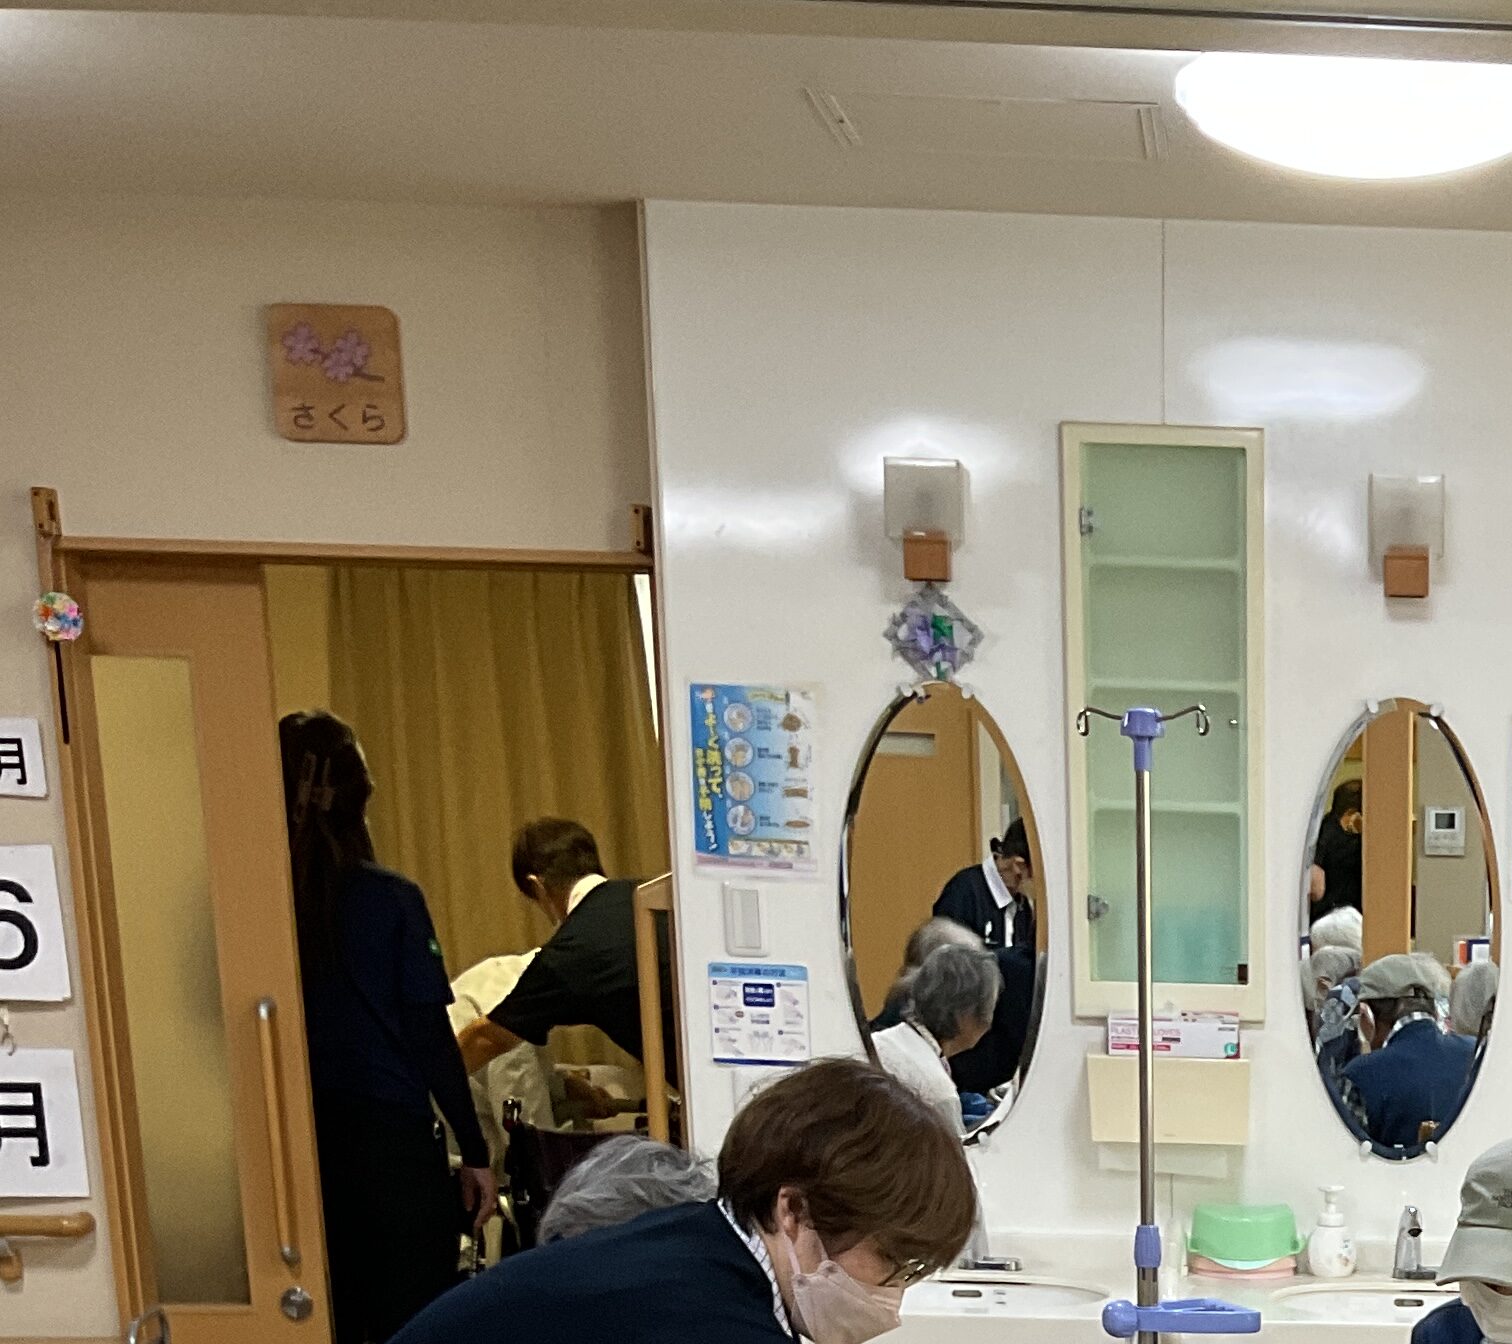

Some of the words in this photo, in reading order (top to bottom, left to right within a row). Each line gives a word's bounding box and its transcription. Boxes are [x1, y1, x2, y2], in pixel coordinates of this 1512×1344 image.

[291, 402, 386, 432] さくら
[0, 879, 39, 970] 6
